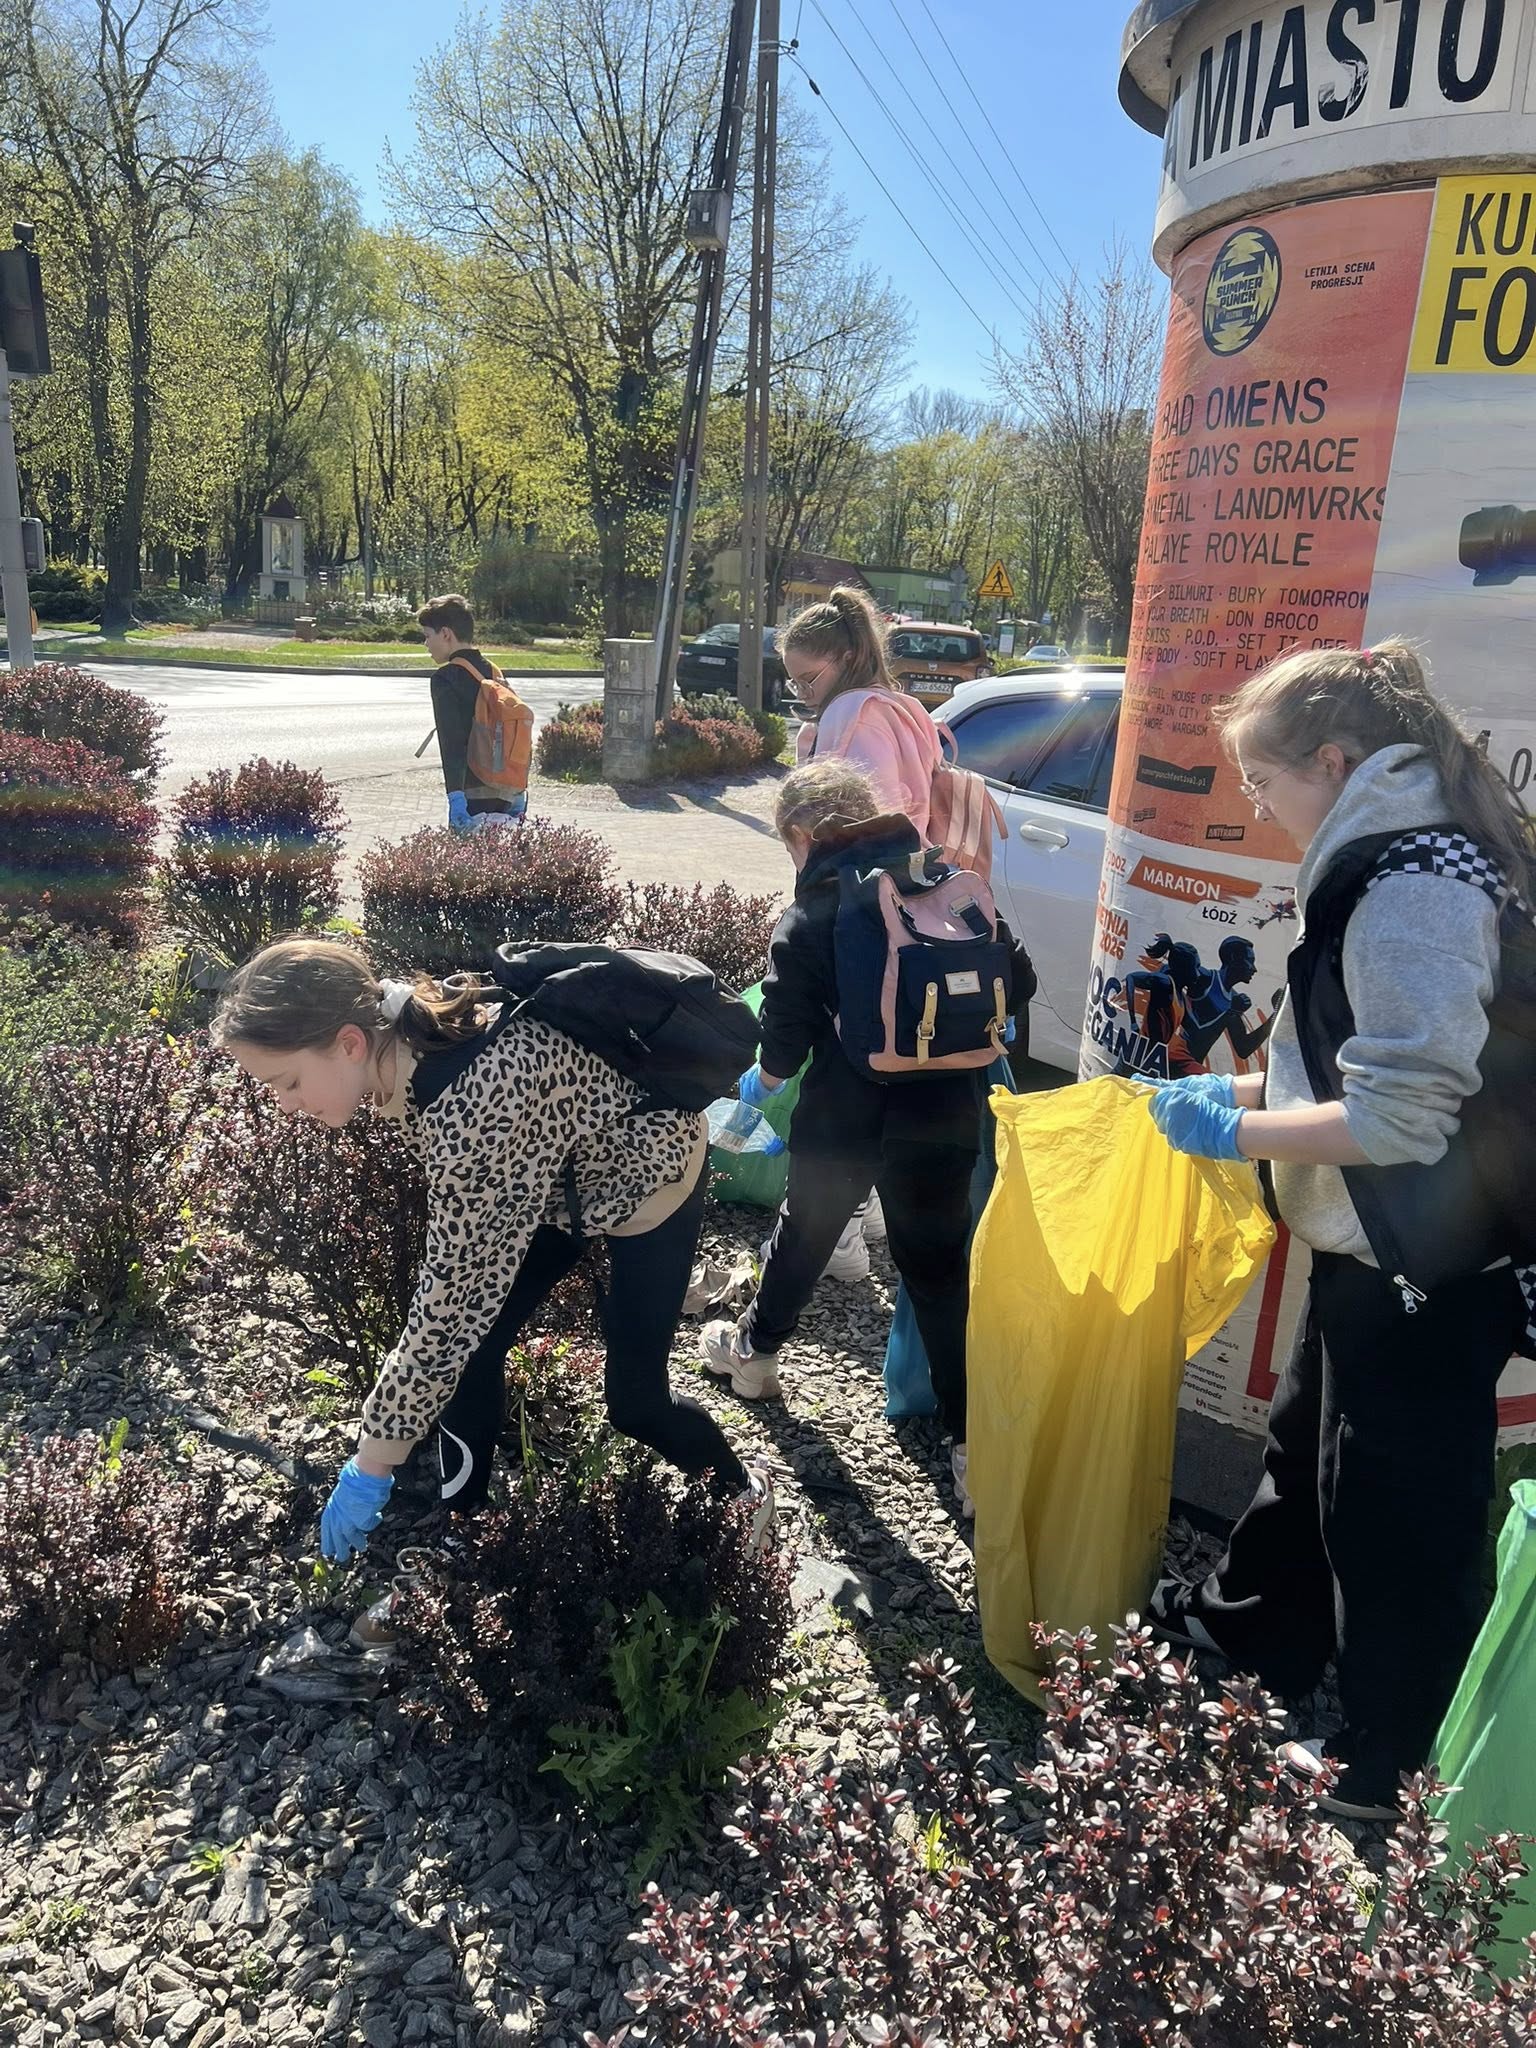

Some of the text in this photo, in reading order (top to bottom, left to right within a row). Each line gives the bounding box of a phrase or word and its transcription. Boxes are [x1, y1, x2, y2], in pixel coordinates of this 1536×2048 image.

[1188, 0, 1504, 170] MIASTO
[1456, 193, 1536, 255] KU
[1305, 261, 1376, 278] LETNIA SCENA
[1216, 276, 1263, 298] SUMMER
[1310, 275, 1364, 290] PROGRESJI
[1220, 290, 1256, 307] PUNCH
[1160, 377, 1328, 440] BAD OMENS
[1186, 443, 1240, 478] DAYS
[1254, 438, 1359, 474] GRACE
[1145, 531, 1314, 566] PALAYE ROYALE
[1168, 584, 1214, 602] BILMURI
[1228, 586, 1267, 604] BURY
[1280, 588, 1369, 609] TOMORROW
[1170, 607, 1208, 624] BREATH
[1226, 610, 1254, 628] DON
[1264, 611, 1319, 631] BROCO
[1185, 629, 1218, 646] P.O.D.
[1236, 633, 1266, 650] SET
[1277, 634, 1299, 652] IT
[1157, 648, 1180, 665] BODY
[1193, 650, 1226, 669] SOFT
[1172, 690, 1197, 703] HOUSE
[1201, 693, 1213, 704] OF
[1157, 703, 1175, 716] RAIN
[1179, 706, 1200, 719] CITY
[1172, 722, 1208, 737] WARGASM
[1143, 866, 1221, 900] MARATON
[1202, 906, 1238, 925] ŁÓDŹ
[1099, 931, 1127, 960] 2026
[1089, 960, 1122, 1018] OC
